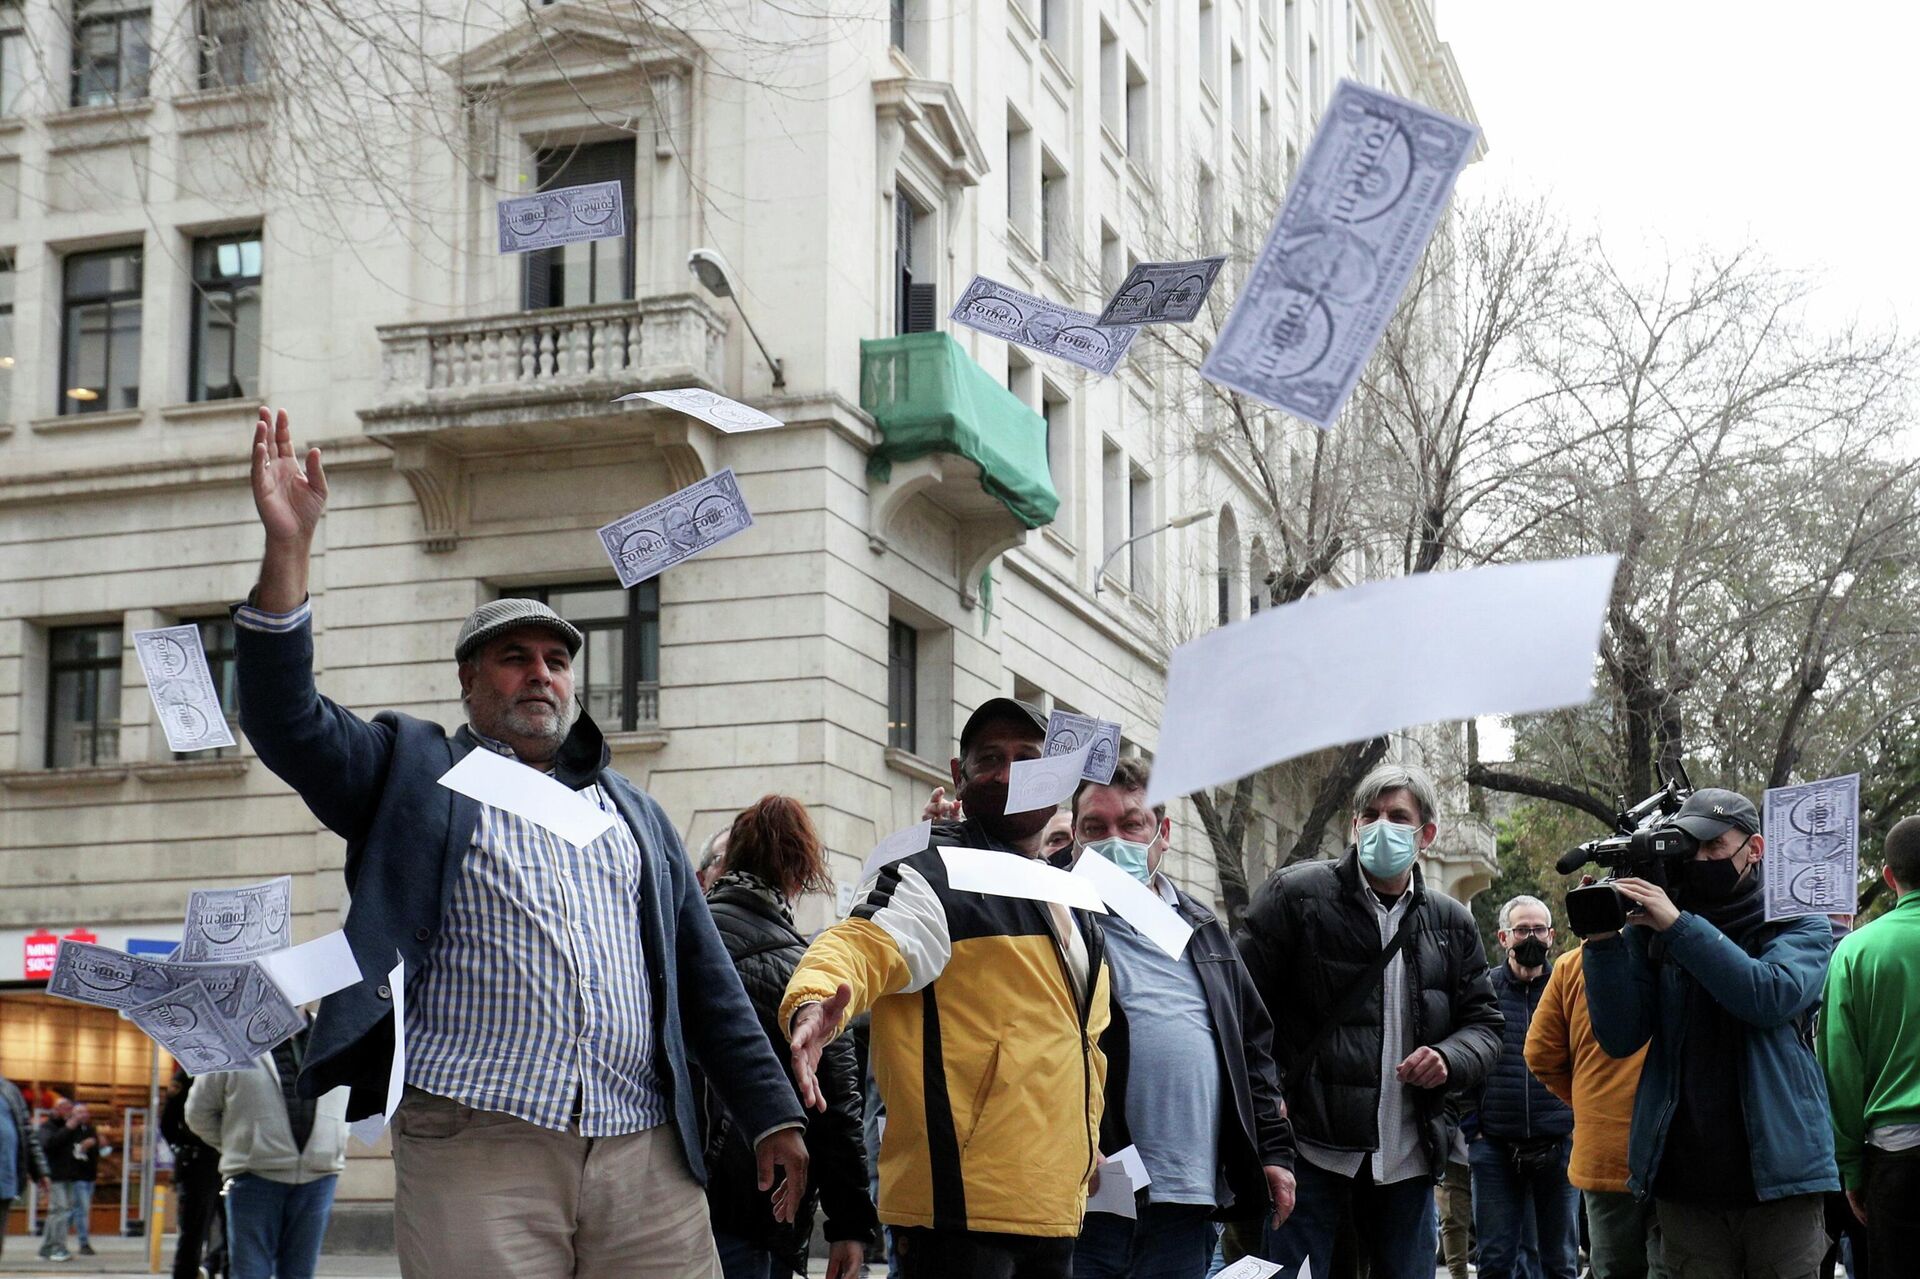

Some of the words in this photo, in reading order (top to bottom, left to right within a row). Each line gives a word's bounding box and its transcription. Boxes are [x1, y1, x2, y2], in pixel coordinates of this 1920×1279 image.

[1330, 108, 1393, 228] Foment
[506, 205, 547, 225] Foment
[571, 195, 615, 213] Foment
[963, 300, 1023, 328] Foment
[1110, 296, 1153, 313] Foment
[1053, 332, 1110, 357] Foment
[1253, 283, 1313, 382] Foment
[692, 501, 738, 536] Foment
[619, 534, 669, 570] Foment
[149, 637, 175, 677] Foment
[170, 703, 197, 742] Foment
[1812, 789, 1833, 833] Foment
[1813, 863, 1833, 906] Foment
[198, 904, 246, 925] Foment
[26, 943, 57, 956] MINI
[69, 959, 137, 982] Foment
